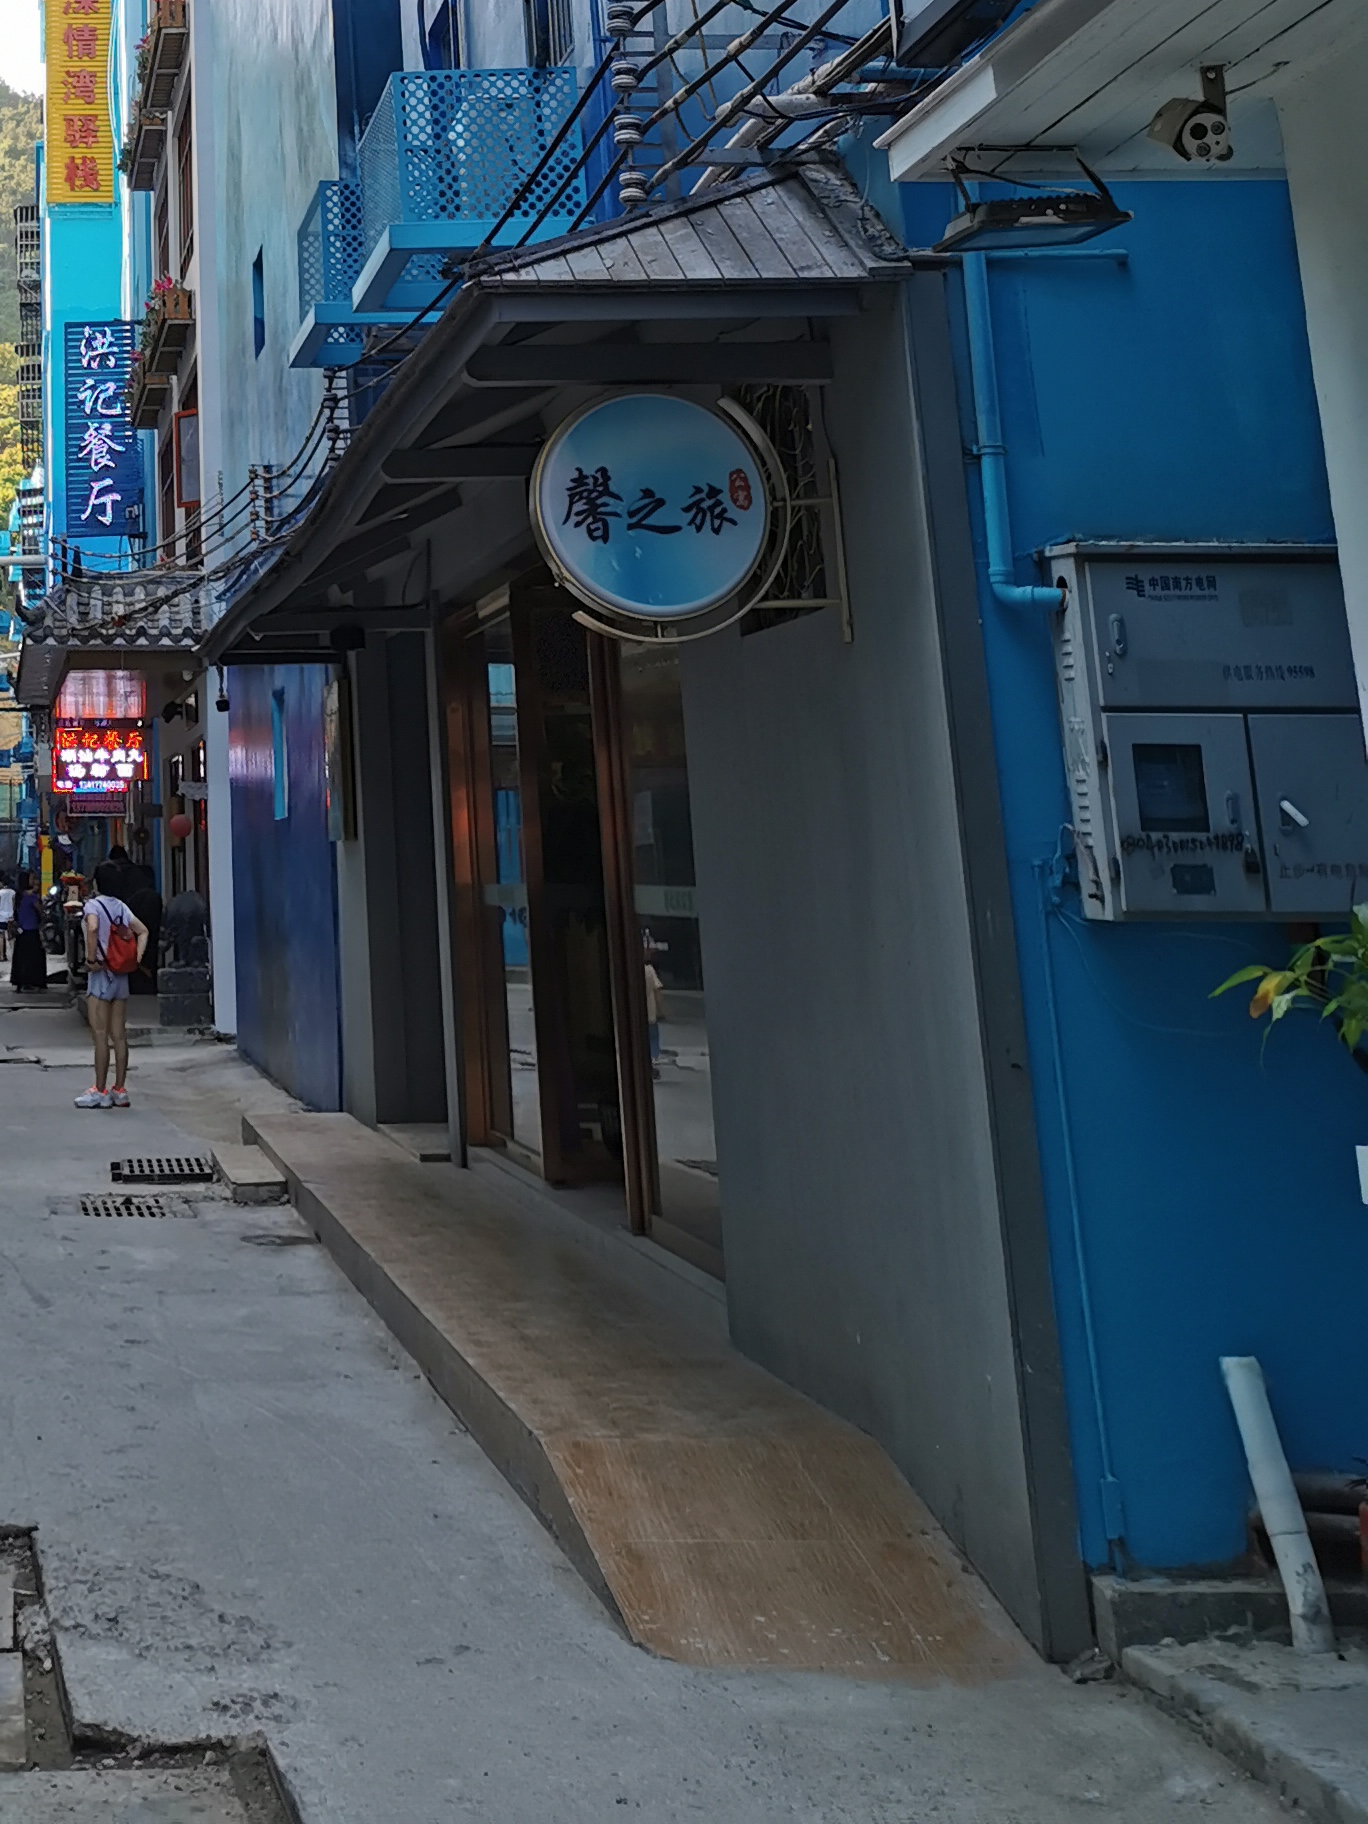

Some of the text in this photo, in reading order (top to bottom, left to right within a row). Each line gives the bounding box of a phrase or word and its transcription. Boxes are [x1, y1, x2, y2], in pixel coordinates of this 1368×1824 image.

[78, 325, 126, 526] 洪记餐厅
[562, 466, 738, 544] 馨之旅
[1148, 575, 1218, 592] 中国南方电网
